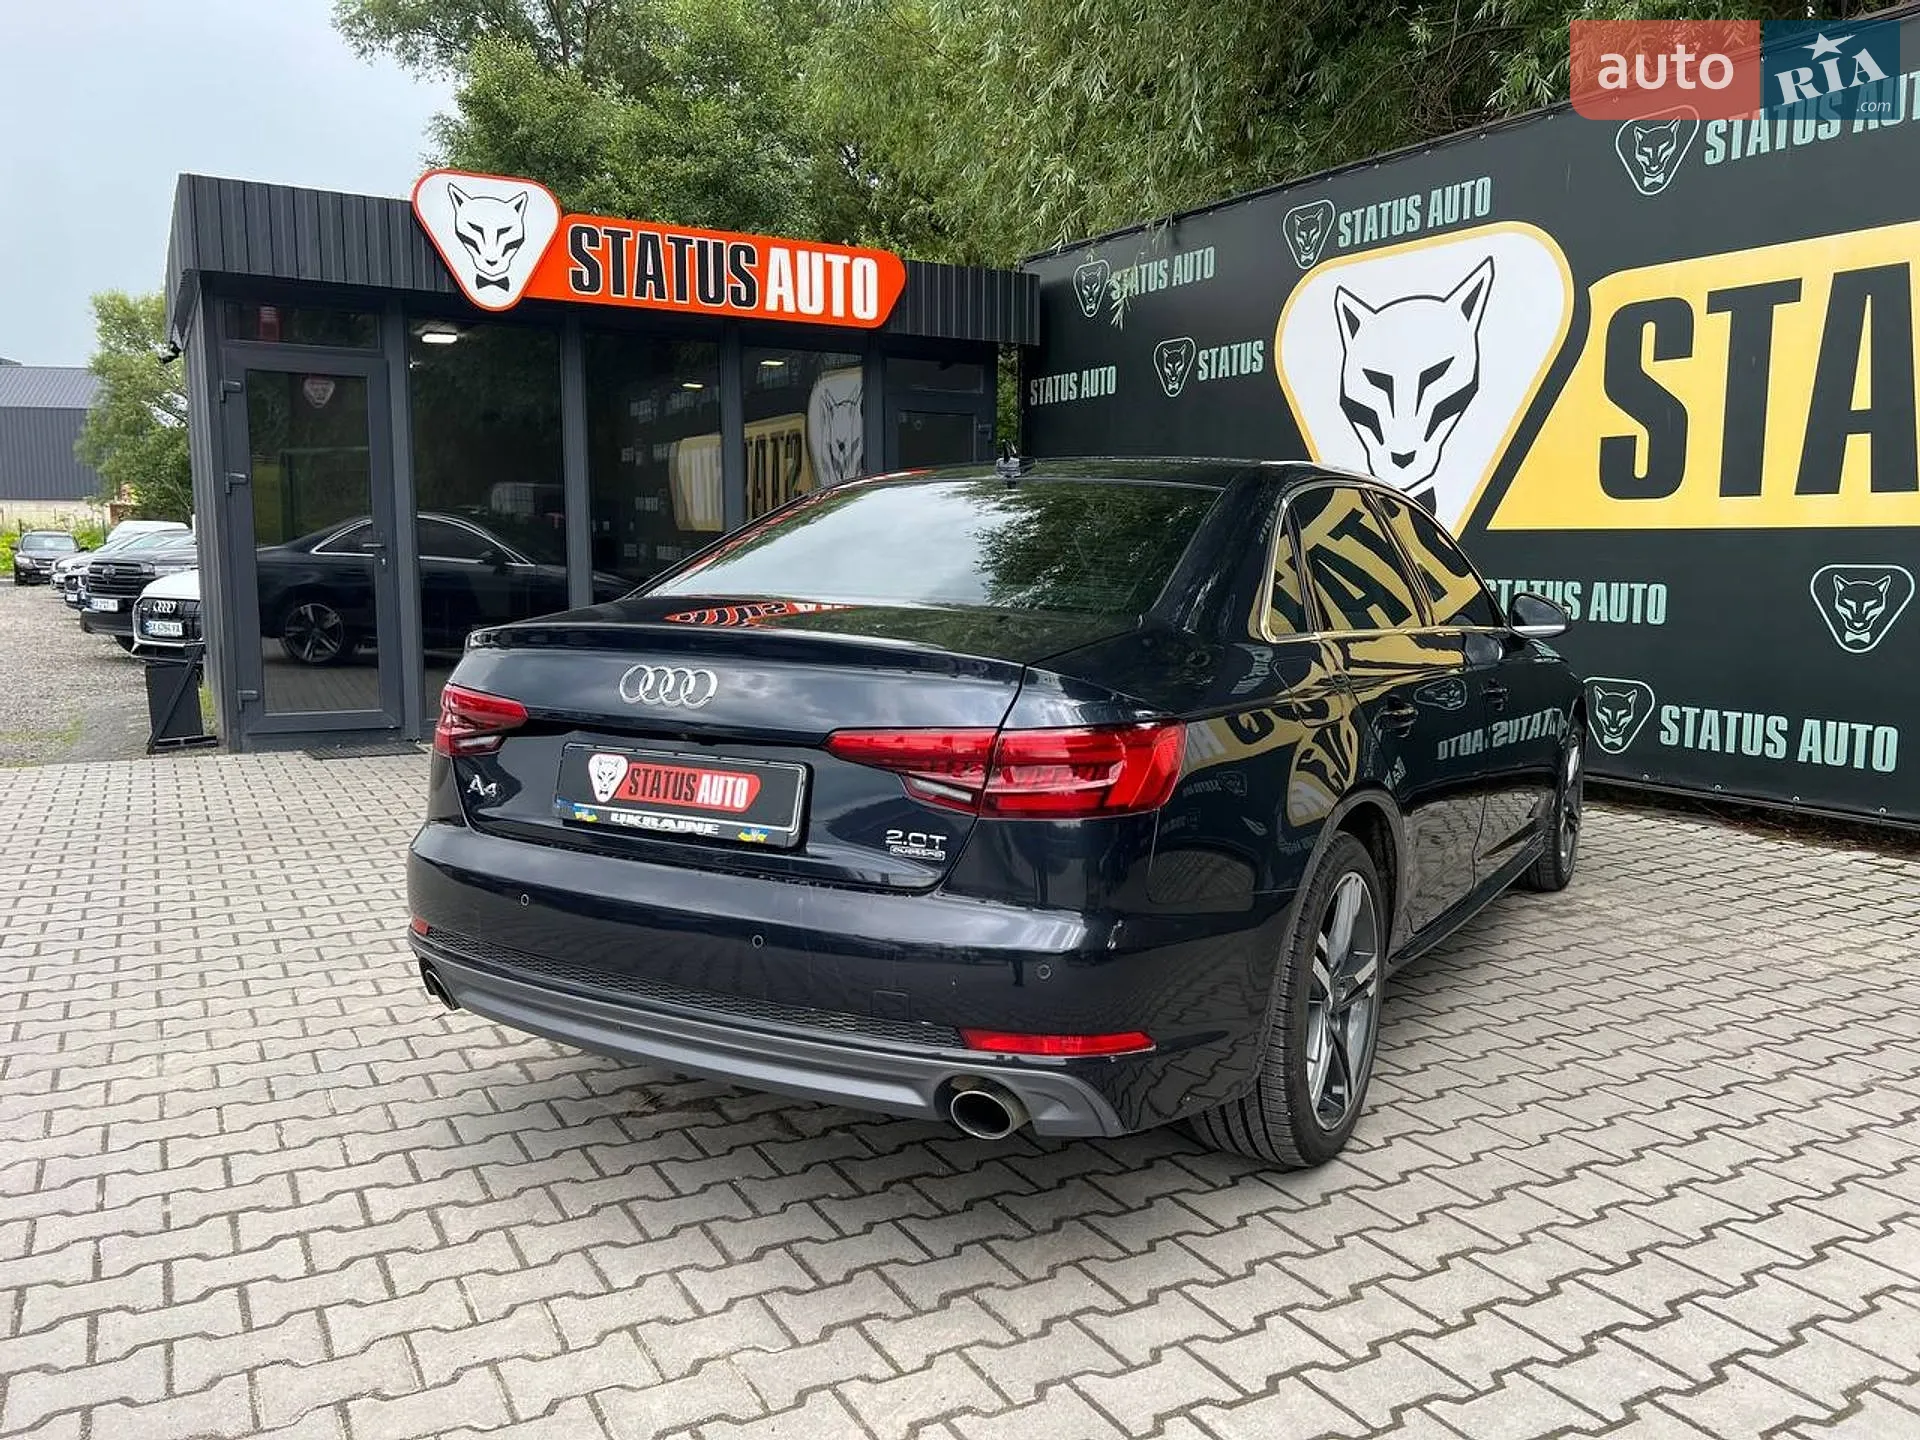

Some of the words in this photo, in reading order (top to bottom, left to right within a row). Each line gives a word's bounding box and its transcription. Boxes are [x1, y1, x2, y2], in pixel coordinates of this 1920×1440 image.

[1704, 91, 1842, 166] STATUS
[1338, 194, 1422, 248] STATUS
[1427, 176, 1492, 229] AUTO
[567, 223, 759, 310] STATUS
[765, 247, 878, 321] AUTO
[1172, 246, 1215, 287] AUTO
[1197, 340, 1264, 382] STATUS
[1030, 371, 1077, 406] STATUS
[1081, 365, 1117, 398] AUTO
[1588, 581, 1668, 625] AUTO
[1659, 704, 1788, 760] STATUS
[1798, 718, 1900, 773] AUTO
[467, 774, 497, 798] A4
[628, 767, 697, 802] STATUS
[696, 774, 749, 809] AUTO
[610, 812, 720, 835] UKRAINE
[886, 829, 947, 850] 2.0T
